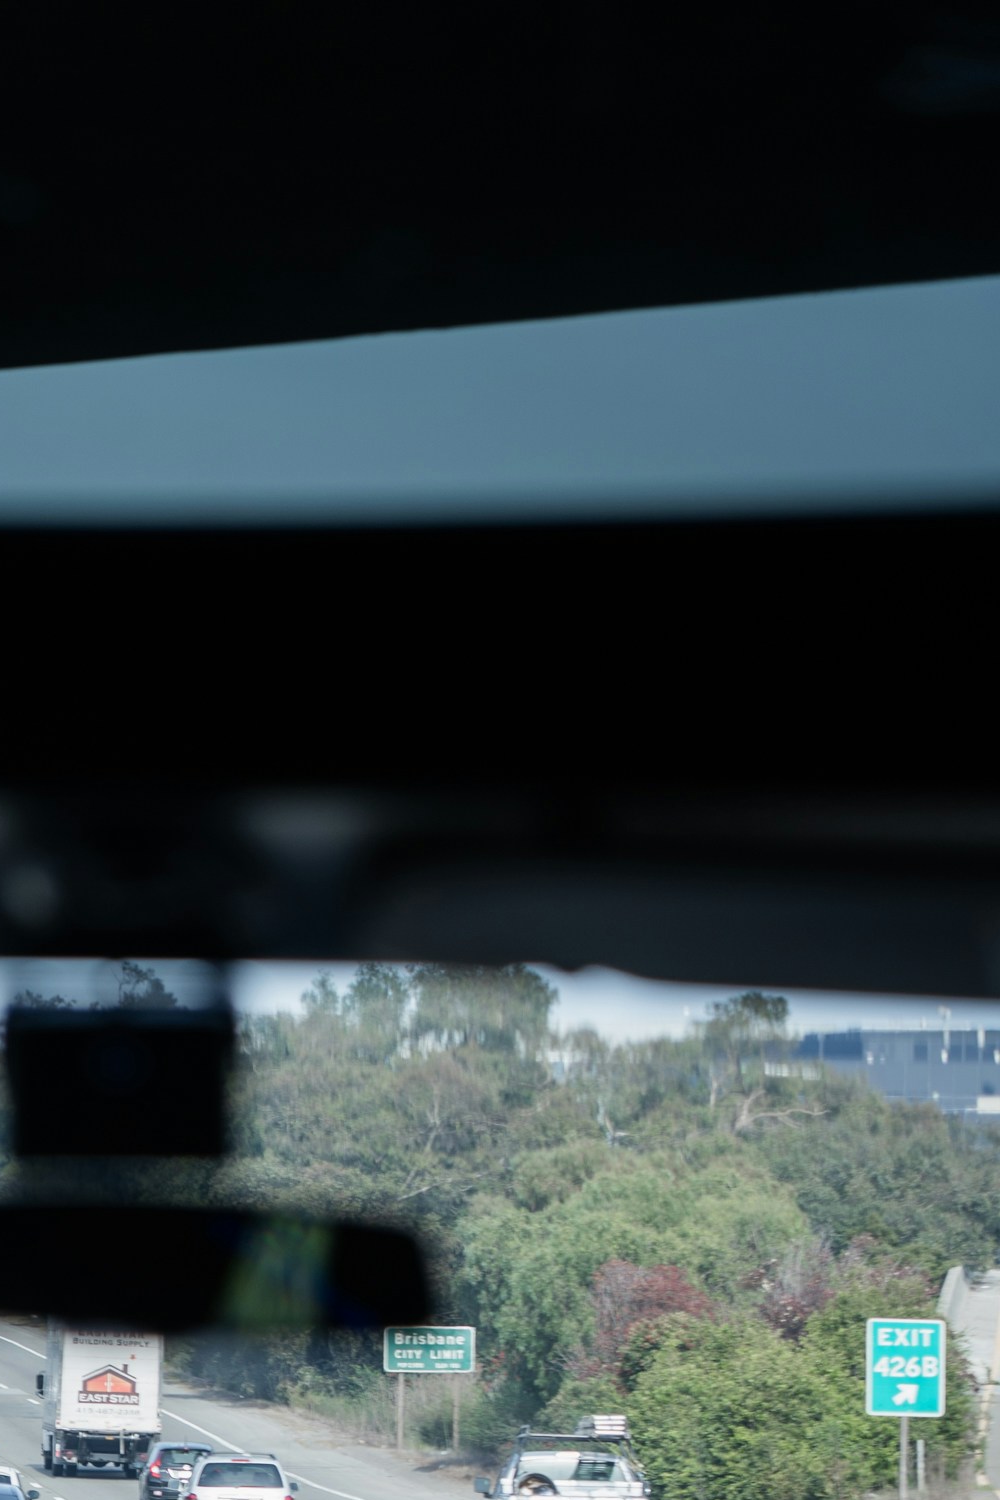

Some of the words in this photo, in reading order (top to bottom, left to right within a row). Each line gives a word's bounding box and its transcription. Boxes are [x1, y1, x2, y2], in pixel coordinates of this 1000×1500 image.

[73, 1337, 114, 1346] BUILDING
[116, 1339, 150, 1348] SUPPLY
[394, 1333, 465, 1345] Brisbane
[877, 1328, 936, 1347] EXIT
[394, 1349, 423, 1359] CITY
[430, 1349, 464, 1359] LIMIT
[873, 1356, 939, 1378] 426B
[79, 1393, 109, 1403] EAST
[109, 1394, 139, 1405] STAR
